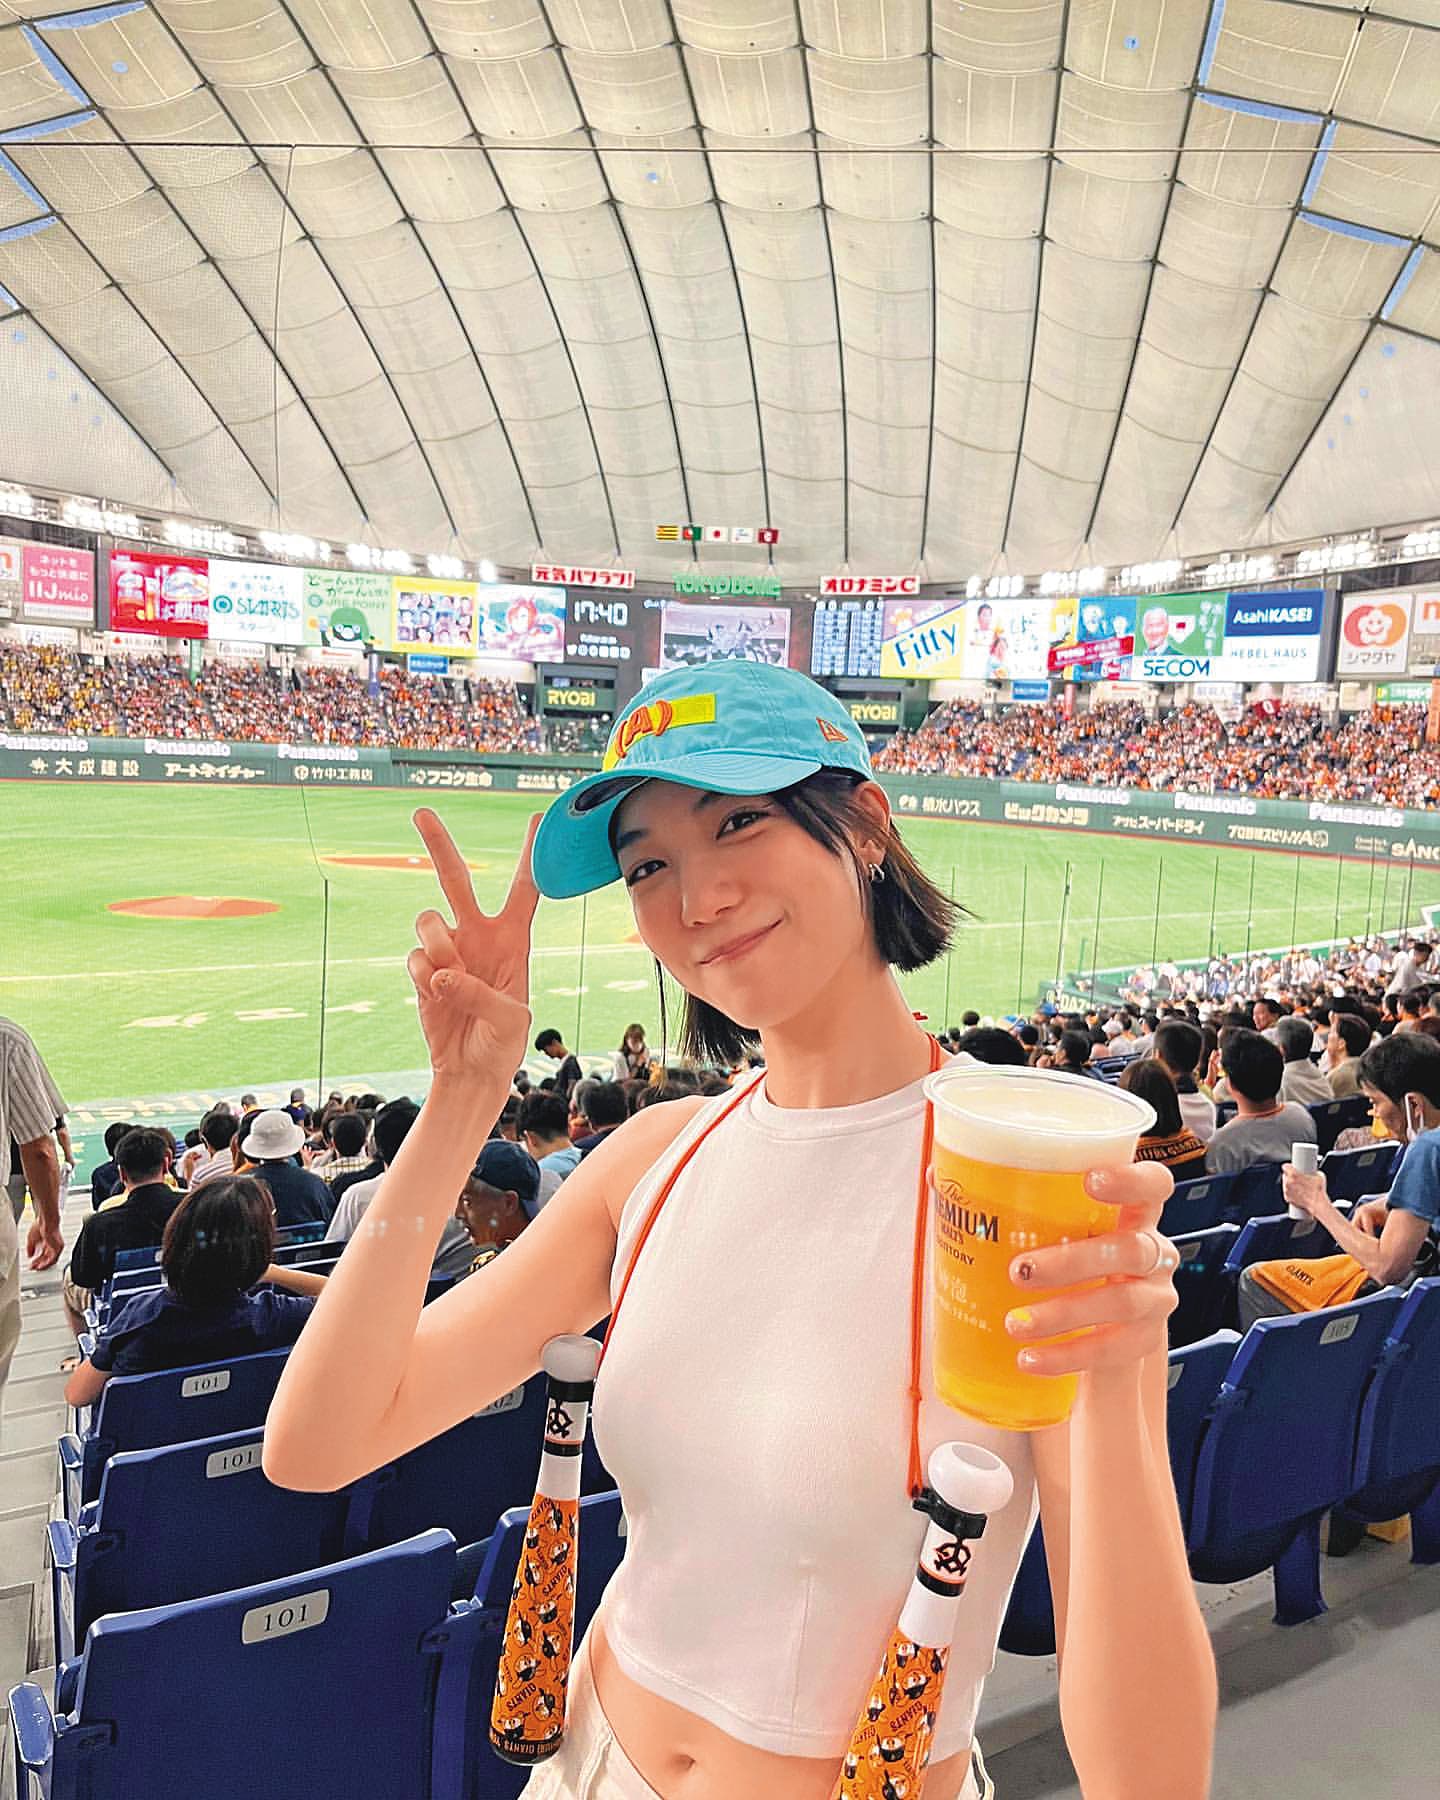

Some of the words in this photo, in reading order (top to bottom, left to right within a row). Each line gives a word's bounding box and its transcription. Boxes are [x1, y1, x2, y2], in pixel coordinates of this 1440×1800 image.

[574, 600, 628, 626] 17:40
[1143, 658, 1210, 677] SECOM
[547, 689, 595, 707] RYOBI
[851, 704, 897, 721] RYOBI
[144, 738, 231, 757] Panasonic
[277, 744, 358, 761] Panasonic
[55, 758, 139, 777] 大成建設
[164, 763, 265, 779] アートネイチャー
[311, 768, 373, 782] 竹中工務店
[1055, 784, 1130, 805] Panasonic
[1174, 792, 1256, 815] Panasonic
[1004, 803, 1089, 826] ビックカメラ
[1308, 803, 1404, 827] Panasonic
[936, 1193, 999, 1242] EMIUM
[193, 1375, 219, 1392] 101
[223, 1451, 253, 1470] 101
[264, 1603, 309, 1632] 101
[506, 1682, 537, 1711] GIANTS
[890, 1701, 924, 1733] GIANTS
